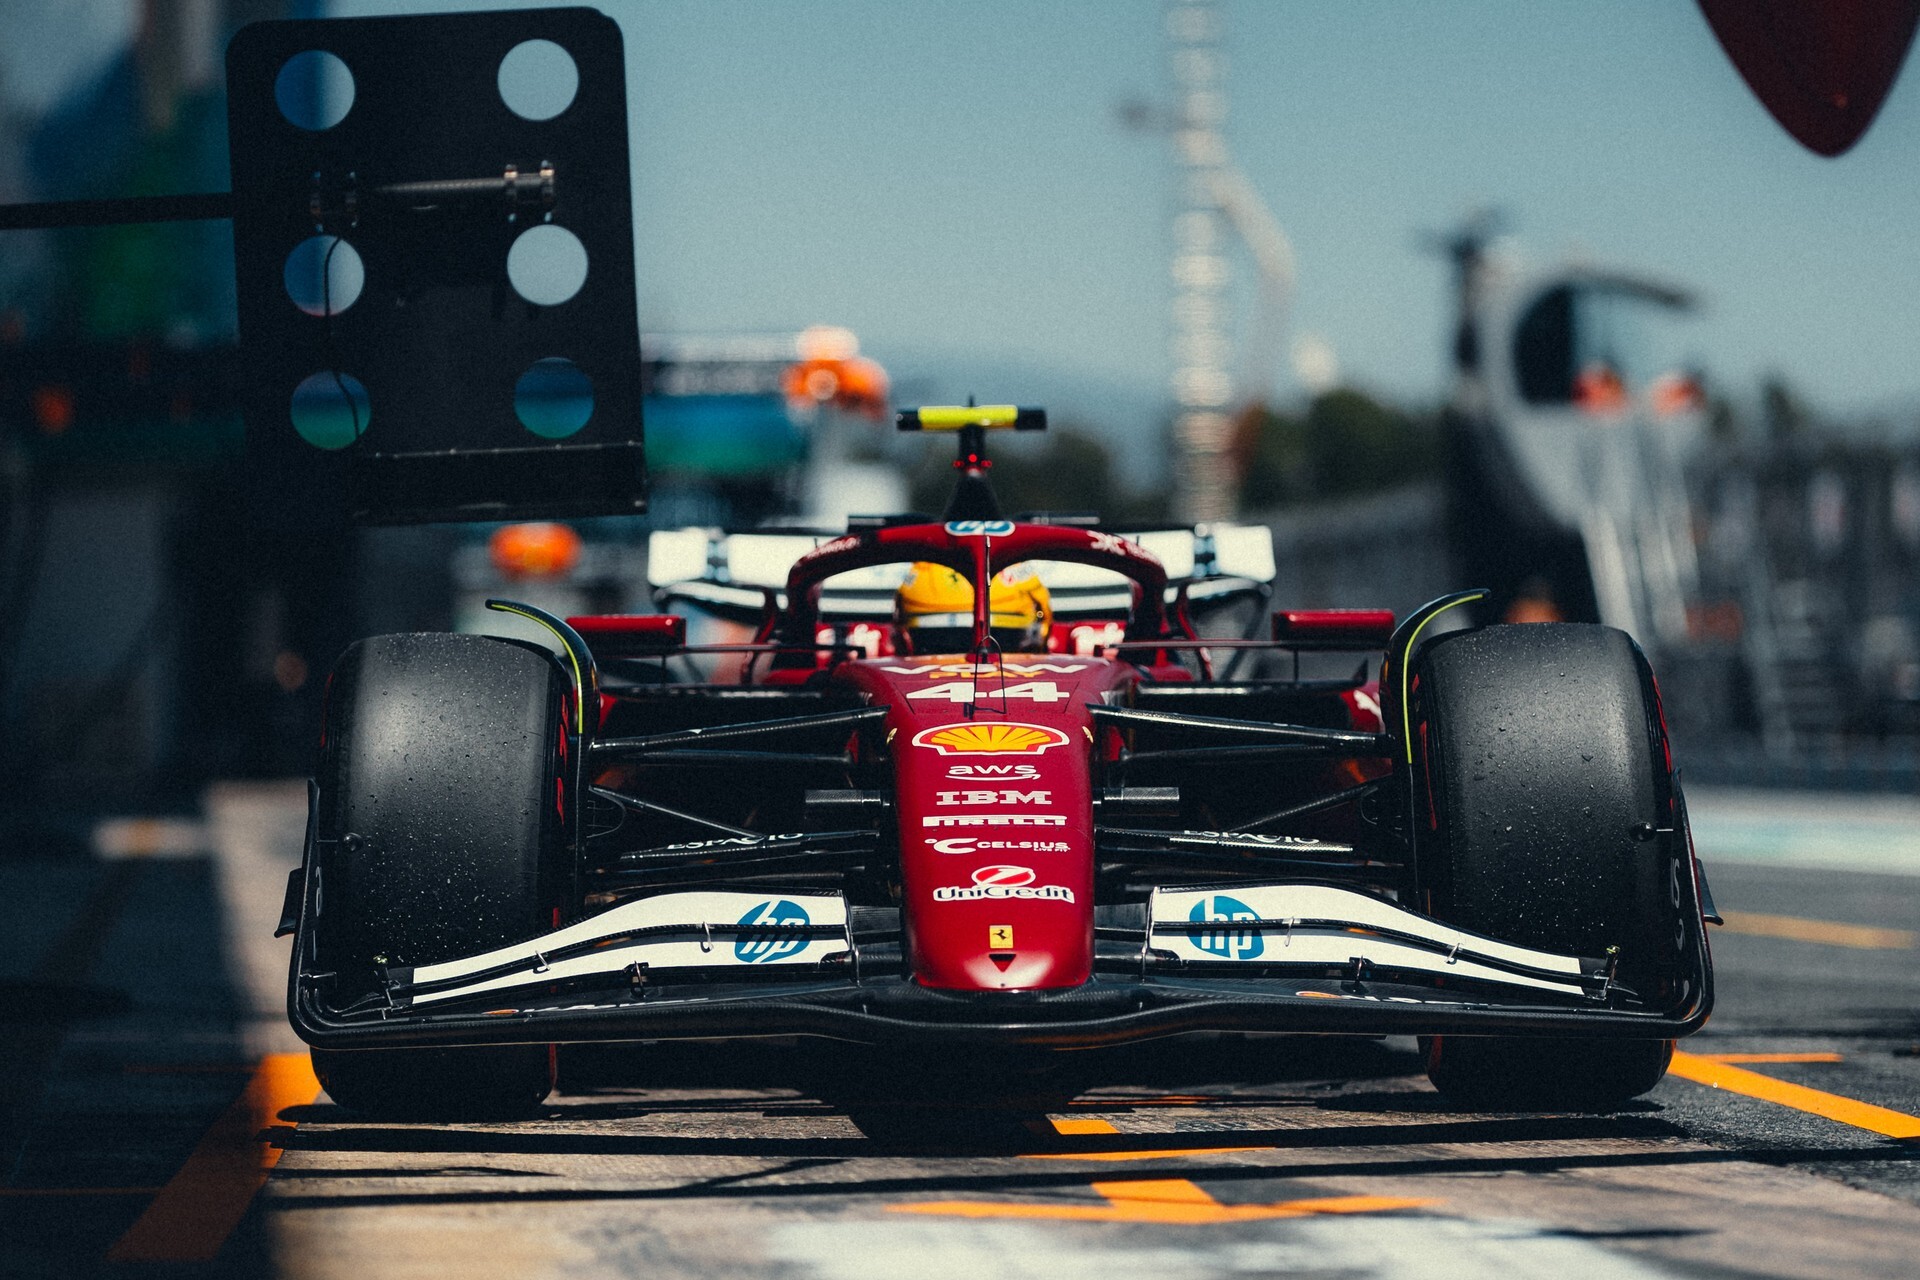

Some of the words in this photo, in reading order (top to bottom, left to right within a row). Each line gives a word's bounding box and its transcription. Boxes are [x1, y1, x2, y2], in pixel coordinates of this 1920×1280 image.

[906, 682, 1070, 702] 44
[948, 764, 1037, 775] aws
[936, 790, 1052, 805] IBM
[922, 814, 1067, 827] PIRELLI
[977, 841, 1068, 849] CELSIUS
[935, 885, 1074, 902] UniCredit
[738, 900, 808, 962] hp
[1197, 897, 1260, 959] hp
